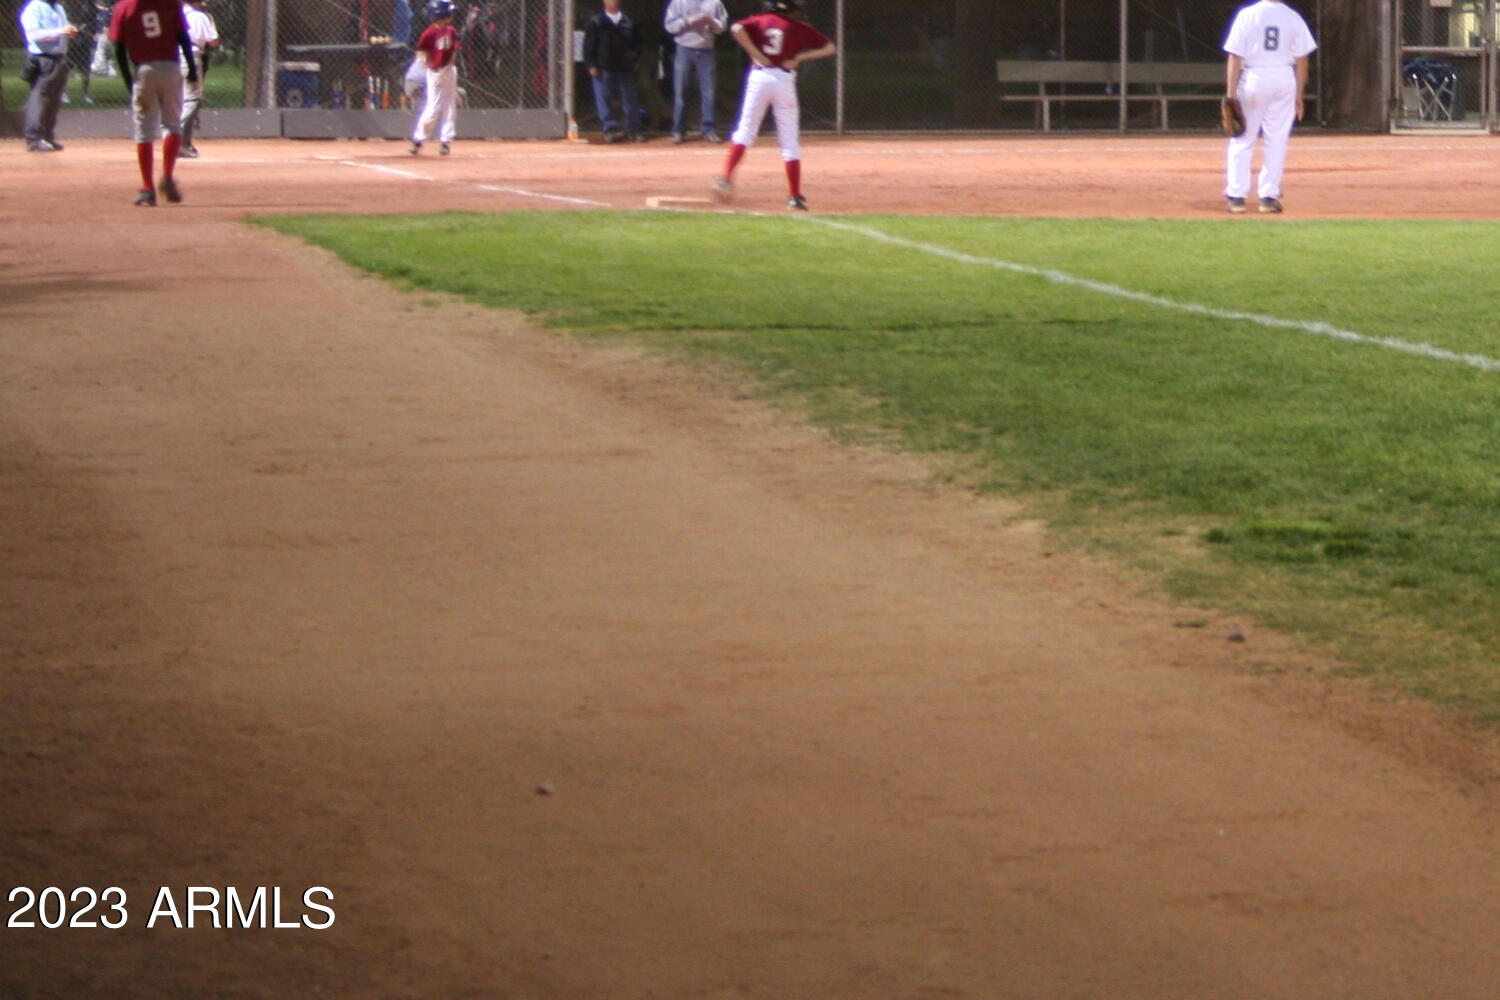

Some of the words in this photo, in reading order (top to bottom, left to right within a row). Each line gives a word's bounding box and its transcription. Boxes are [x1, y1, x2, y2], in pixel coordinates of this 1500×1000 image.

[142, 11, 161, 38] 9
[762, 27, 784, 55] 3
[1264, 26, 1279, 51] 8
